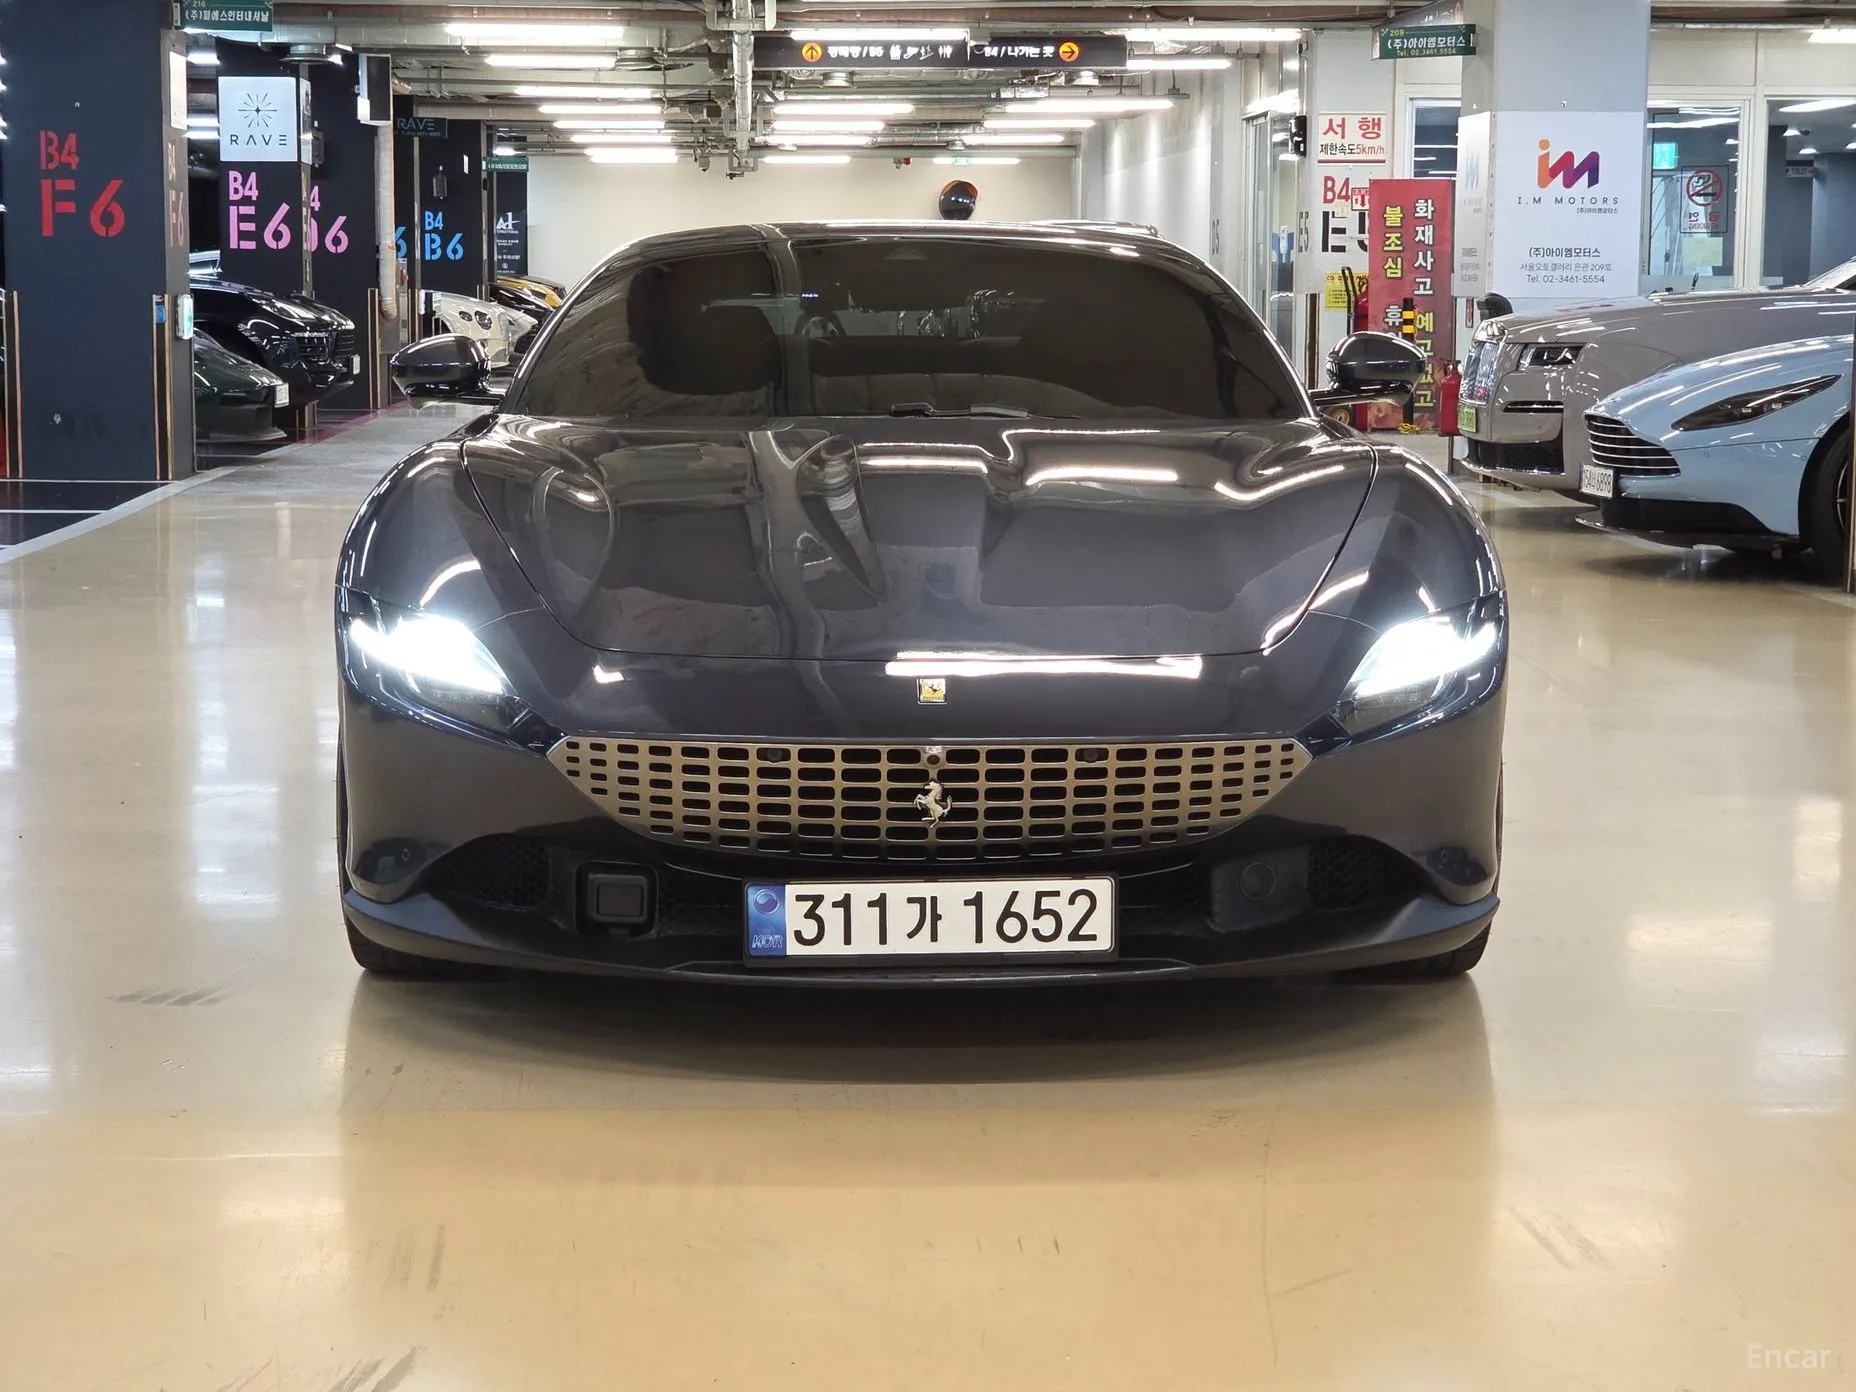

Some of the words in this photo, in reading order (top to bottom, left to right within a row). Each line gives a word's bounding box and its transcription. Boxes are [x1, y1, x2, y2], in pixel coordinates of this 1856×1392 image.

[1387, 35, 1466, 50] (주)아이엠모터스
[1389, 28, 1405, 37] 209
[40, 130, 80, 171] B4
[229, 134, 288, 146] RAVE
[228, 170, 259, 201] B4
[1323, 176, 1351, 204] B4
[1555, 196, 1619, 205] MOTORS
[424, 210, 444, 231] B4
[1383, 206, 1403, 278] 불조심
[1414, 199, 1435, 295] 화재사고
[1529, 247, 1601, 258] (주)아이엠모터스
[1542, 274, 1606, 284] 02-3461-5554
[963, 888, 1099, 944] 1652
